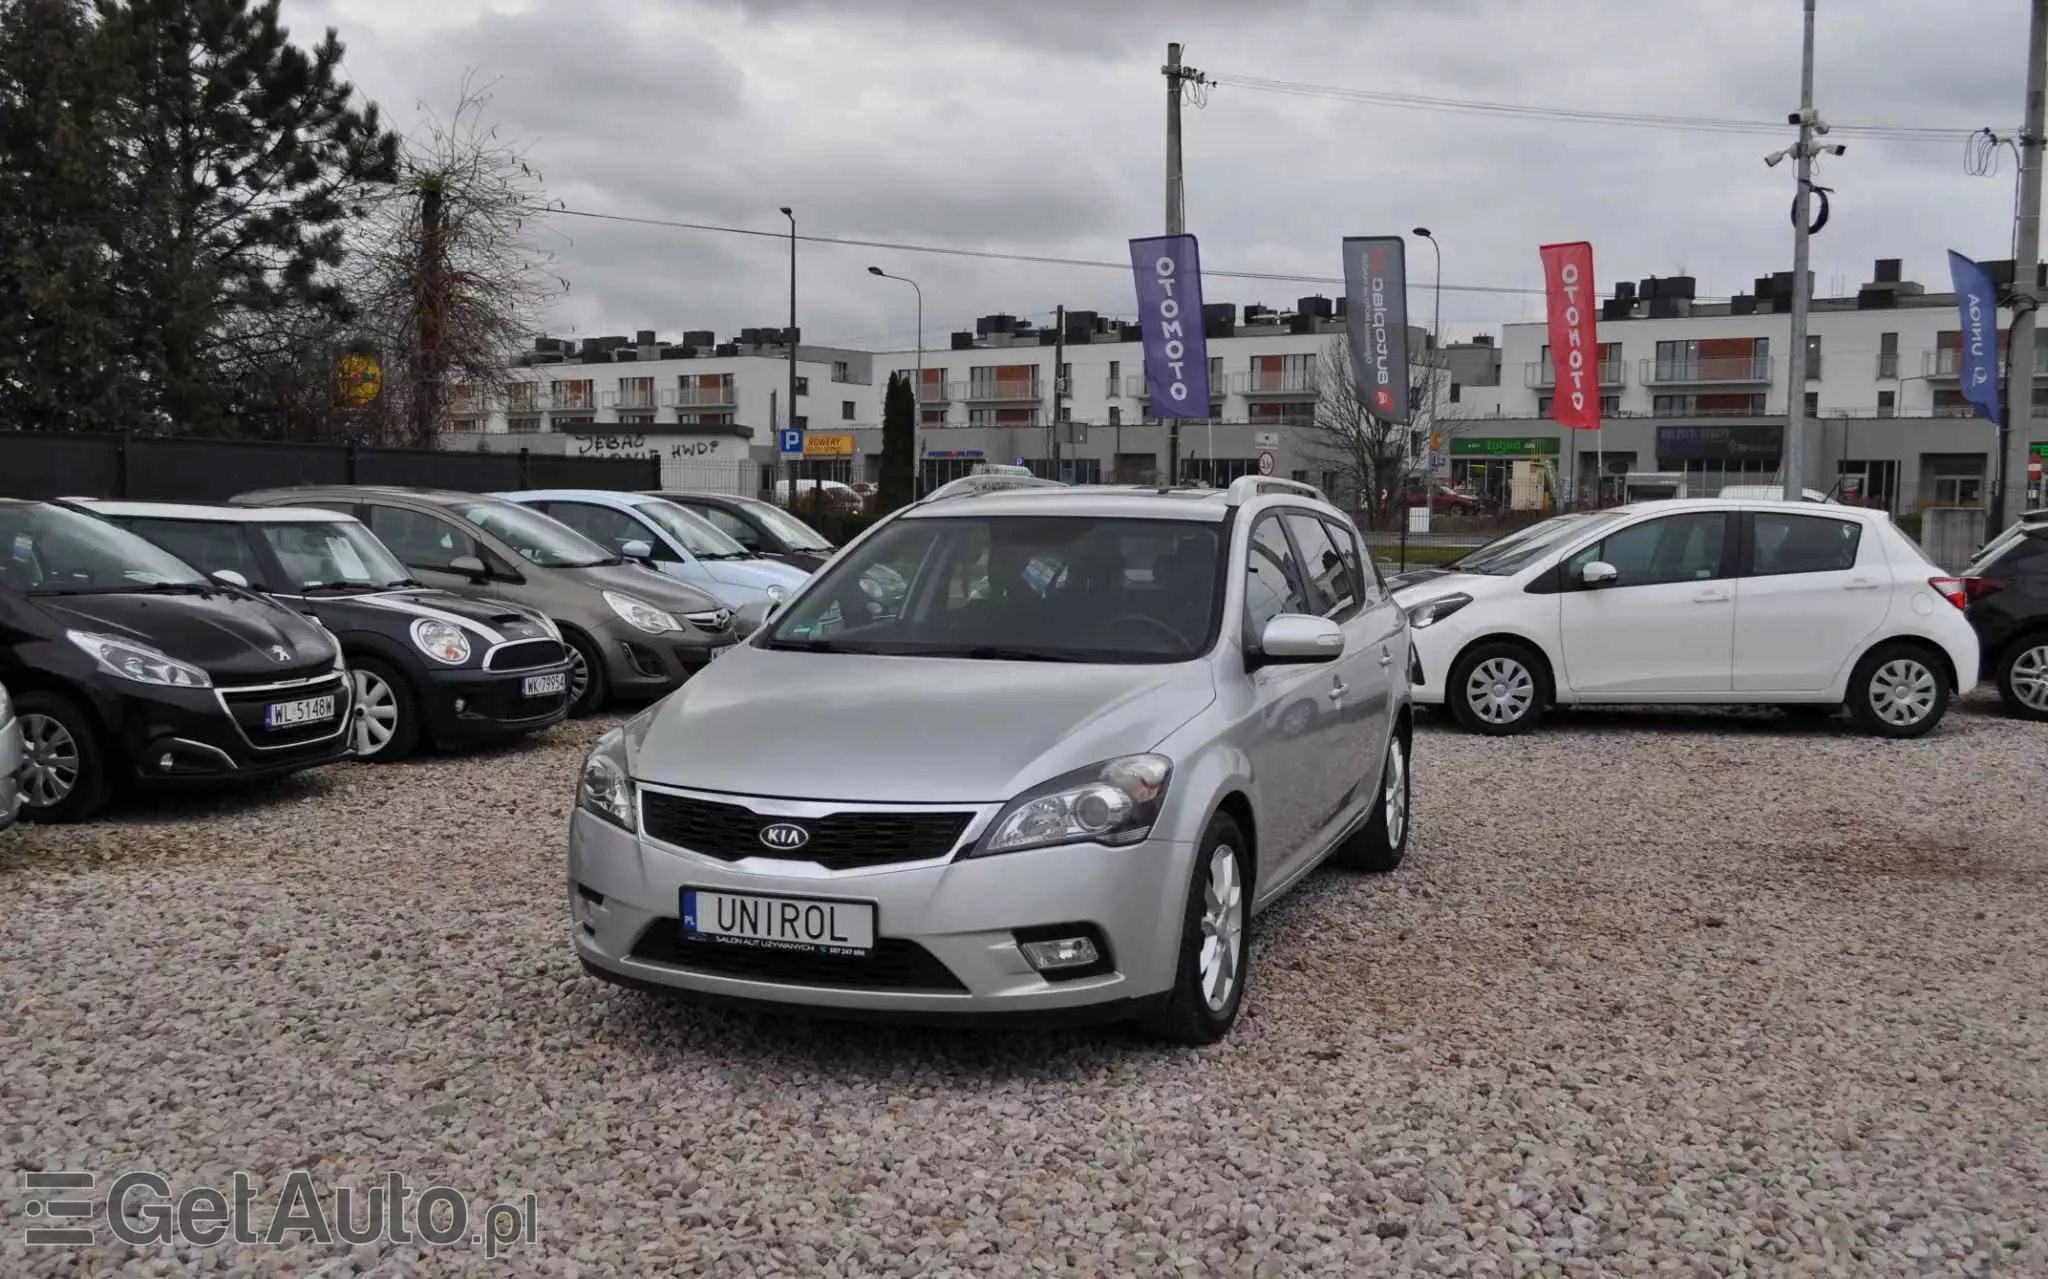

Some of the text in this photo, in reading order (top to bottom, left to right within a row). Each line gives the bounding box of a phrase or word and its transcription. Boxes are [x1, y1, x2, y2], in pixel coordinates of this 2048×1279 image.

[1156, 256, 1188, 401] OTOMOTO
[1561, 263, 1585, 411] OTOMOTO
[785, 431, 800, 450] P
[528, 678, 539, 693] WK
[274, 697, 333, 723] WL 5148W
[767, 828, 799, 844] KIA
[684, 915, 695, 926] PL
[717, 896, 849, 942] UNIROL
[715, 935, 743, 946] SALON
